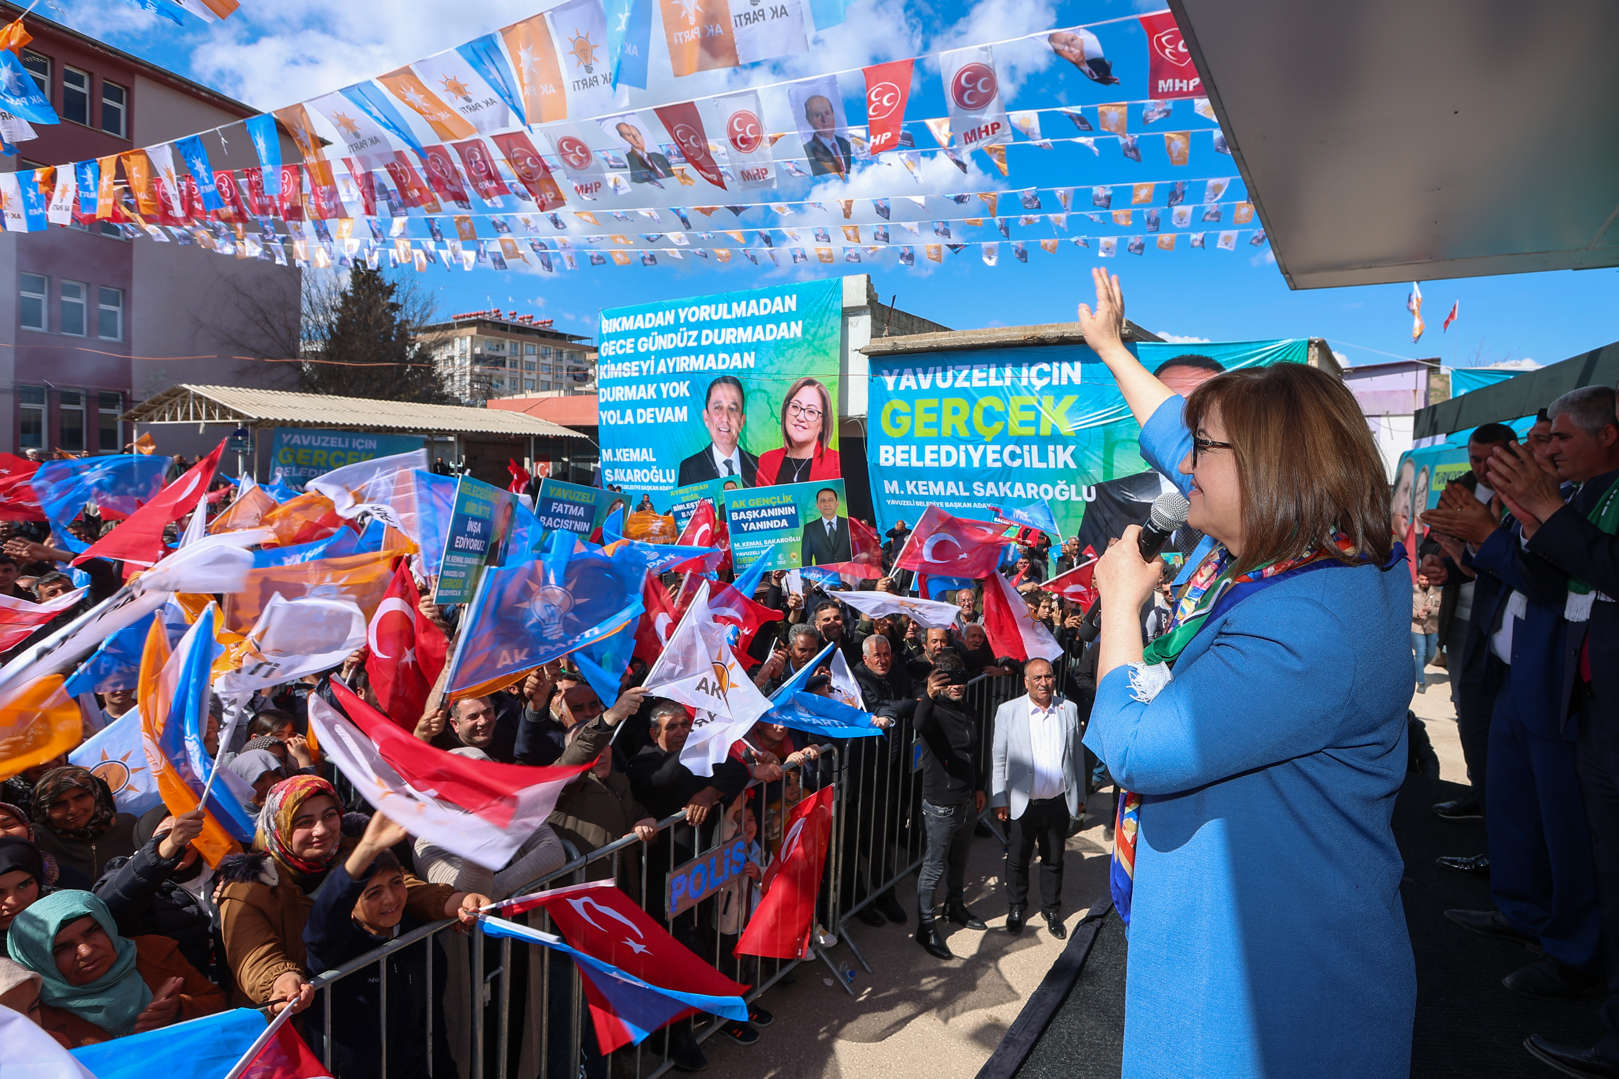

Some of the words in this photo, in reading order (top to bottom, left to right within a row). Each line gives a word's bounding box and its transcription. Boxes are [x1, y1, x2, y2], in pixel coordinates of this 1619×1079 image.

[1158, 77, 1200, 93] MHP
[962, 121, 1001, 145] MHP
[601, 309, 675, 334] BIKMADAN
[678, 294, 797, 323] YORULMADAN
[600, 338, 635, 357] GECE
[637, 327, 698, 352] GÜNDÜZ
[701, 320, 802, 346] DURMADAN
[599, 355, 655, 380] KİMSEYİ
[656, 351, 755, 374] AYIRMADAN
[599, 383, 657, 403] DURMAK
[660, 380, 690, 399] YOK
[600, 409, 635, 426] YOLA
[636, 406, 688, 424] DEVAM
[881, 395, 1079, 442] GERÇEK
[879, 445, 1077, 469] BELEDİYECİLİK
[884, 480, 905, 494] M.
[906, 480, 969, 496] KEMAL
[973, 480, 1096, 502] SAKAROĞLU
[551, 501, 585, 517] FATMA
[731, 499, 746, 509] AK
[731, 506, 796, 522] BAŞKANININ
[741, 518, 788, 532] YANINDA
[454, 534, 485, 552] EDİYORUZ
[695, 677, 721, 700] AK
